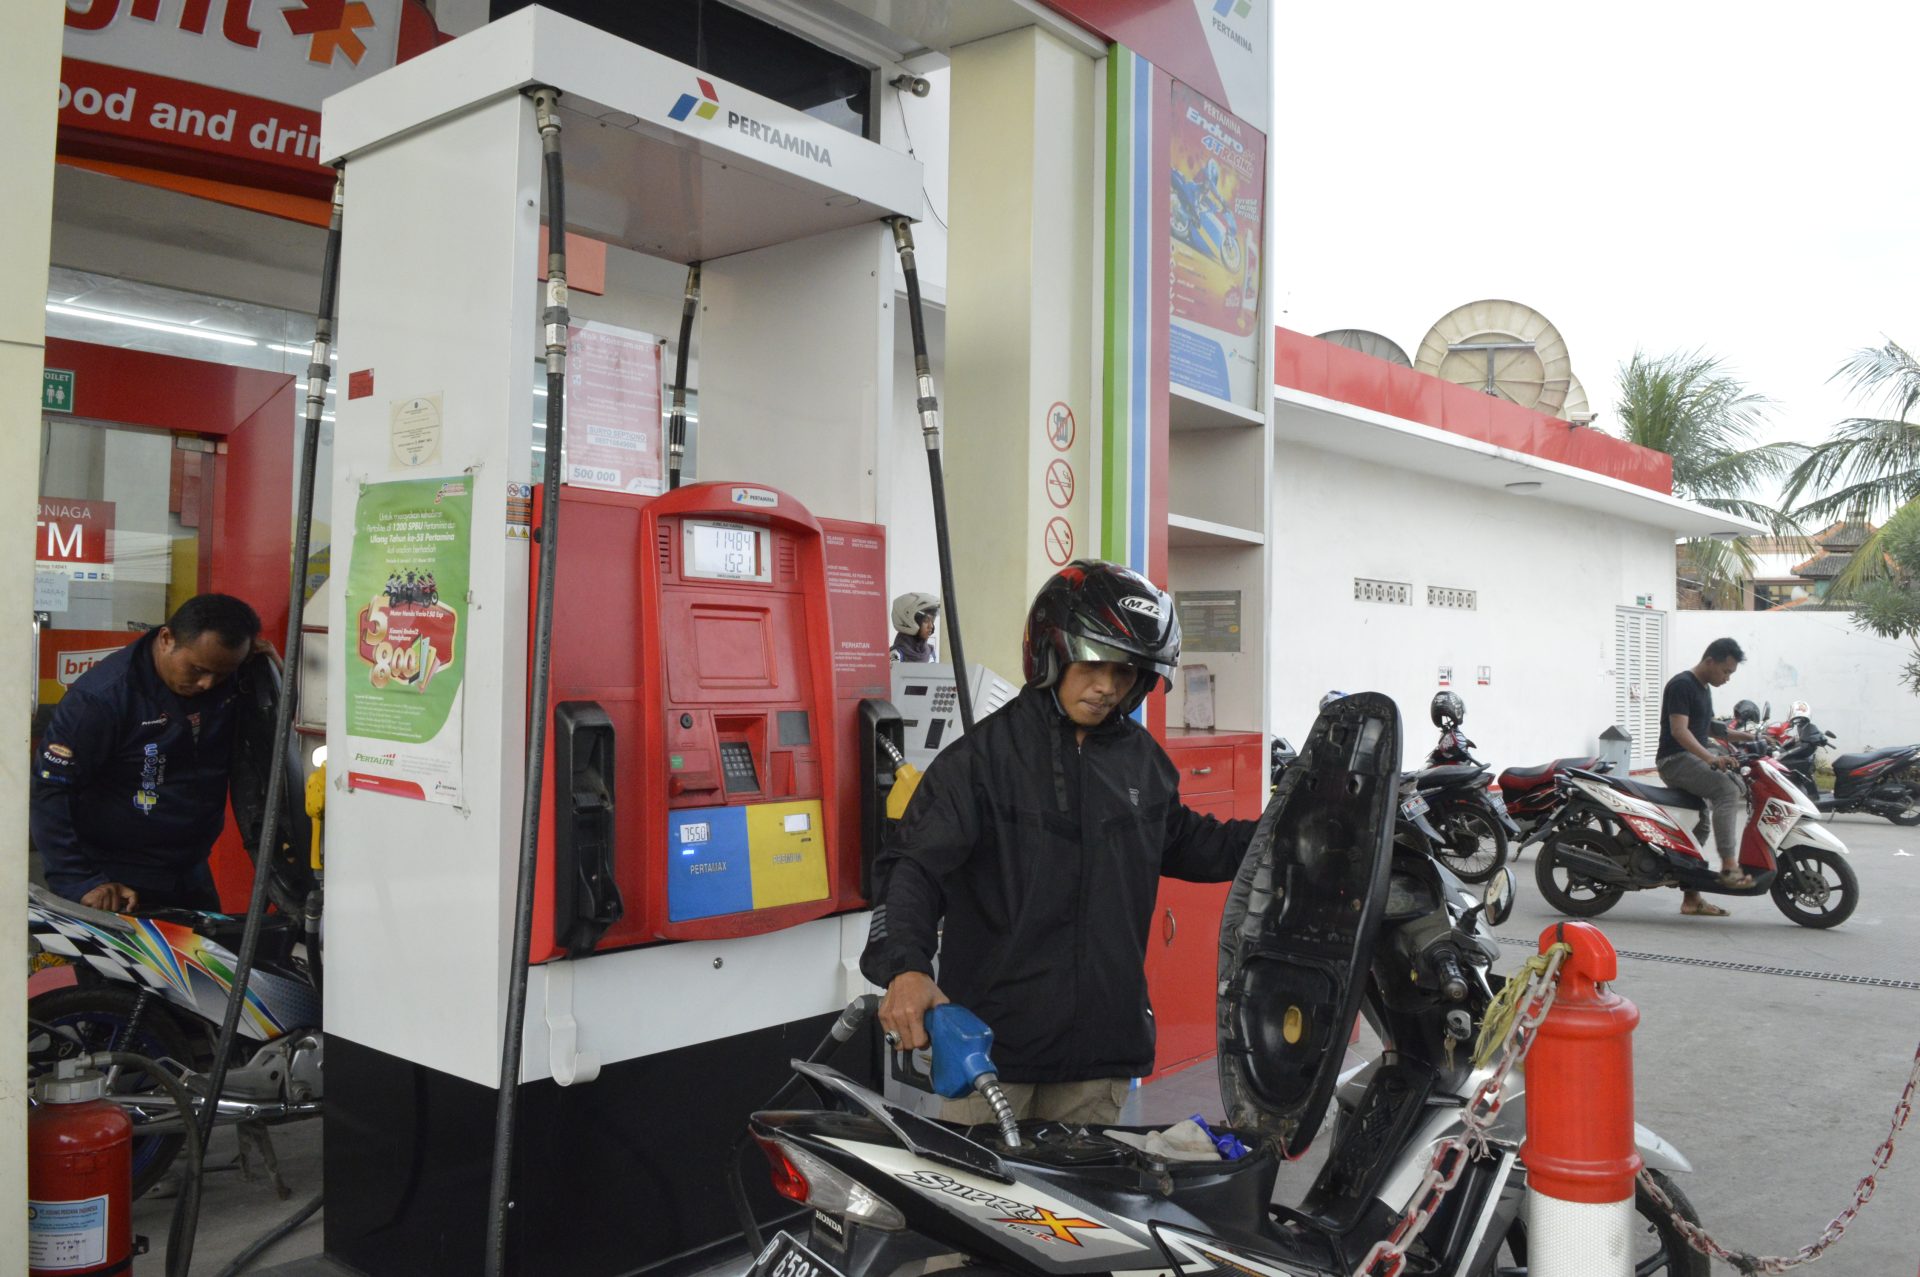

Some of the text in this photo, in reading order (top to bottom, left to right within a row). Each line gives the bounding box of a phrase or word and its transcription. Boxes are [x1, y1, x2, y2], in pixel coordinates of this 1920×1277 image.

[1212, 16, 1253, 54] PERTAMINA
[150, 101, 237, 143] and
[1186, 107, 1244, 153] Enduro
[1203, 100, 1242, 137] PERTAMINA
[728, 111, 833, 167] PERTAMINA
[574, 467, 616, 483] 500 000
[749, 495, 775, 503] PERTAMINA
[45, 504, 92, 519] NIAGA
[392, 522, 407, 531] 1200
[407, 521, 423, 531] SPBU
[370, 535, 388, 545] Ulang
[389, 535, 406, 544] Tahun
[425, 533, 455, 543] Pertamina
[716, 530, 751, 552] 11484
[363, 594, 391, 646] 5
[841, 641, 871, 649] PERHATIAN
[370, 641, 416, 689] 800
[354, 753, 395, 767] PERTALITE
[684, 825, 706, 842] 7550
[690, 861, 727, 875] PERTAMAX
[894, 1170, 1106, 1249] SUPRA X
[815, 1209, 844, 1236] HONDA
[757, 1238, 780, 1267] B
